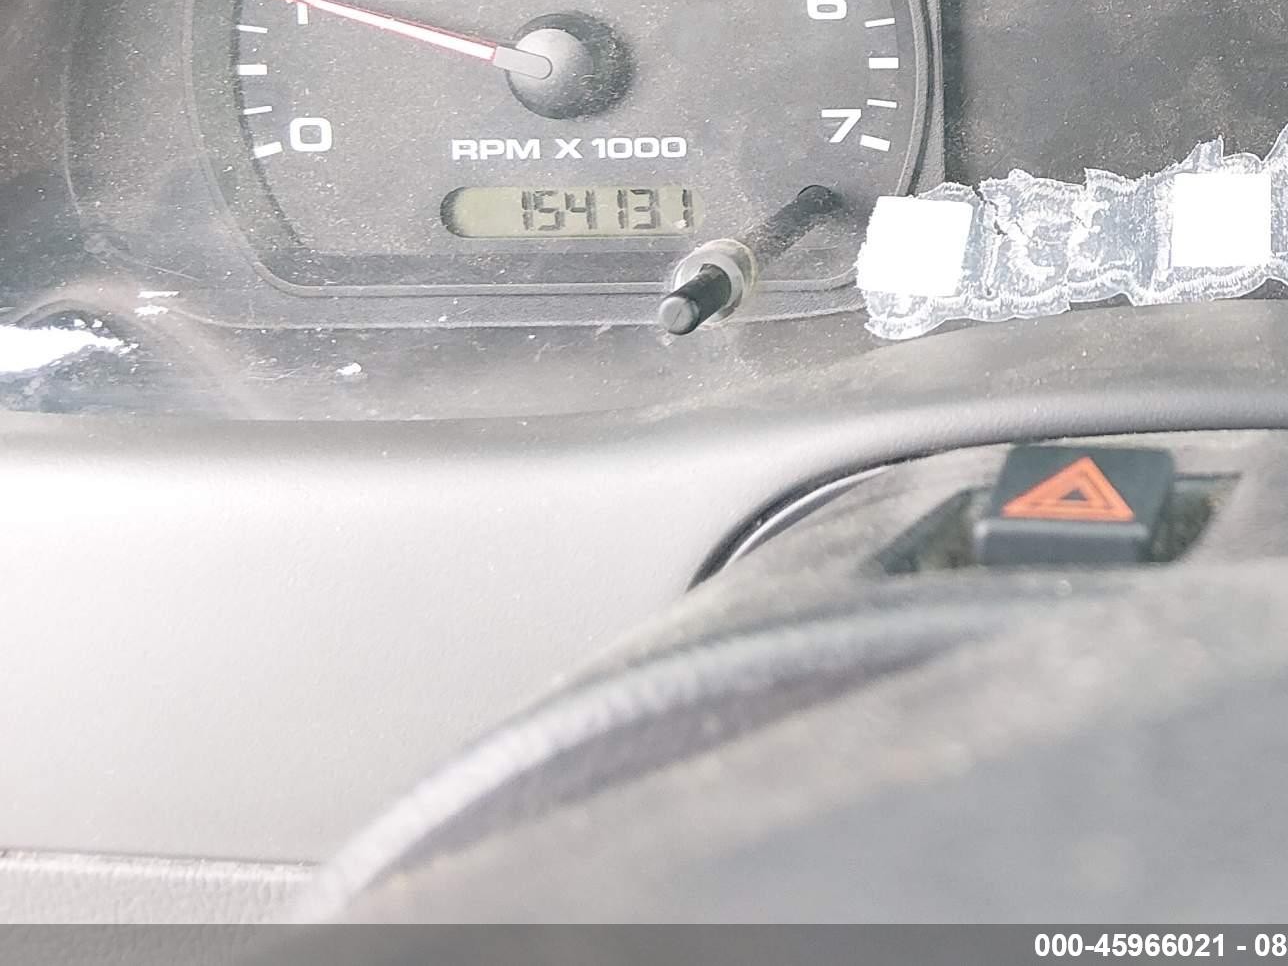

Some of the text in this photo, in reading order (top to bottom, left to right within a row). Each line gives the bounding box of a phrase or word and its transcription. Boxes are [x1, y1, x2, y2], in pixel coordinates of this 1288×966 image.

[290, 118, 332, 152] 0
[822, 109, 862, 143] 7
[452, 137, 686, 160] RPM X 1000
